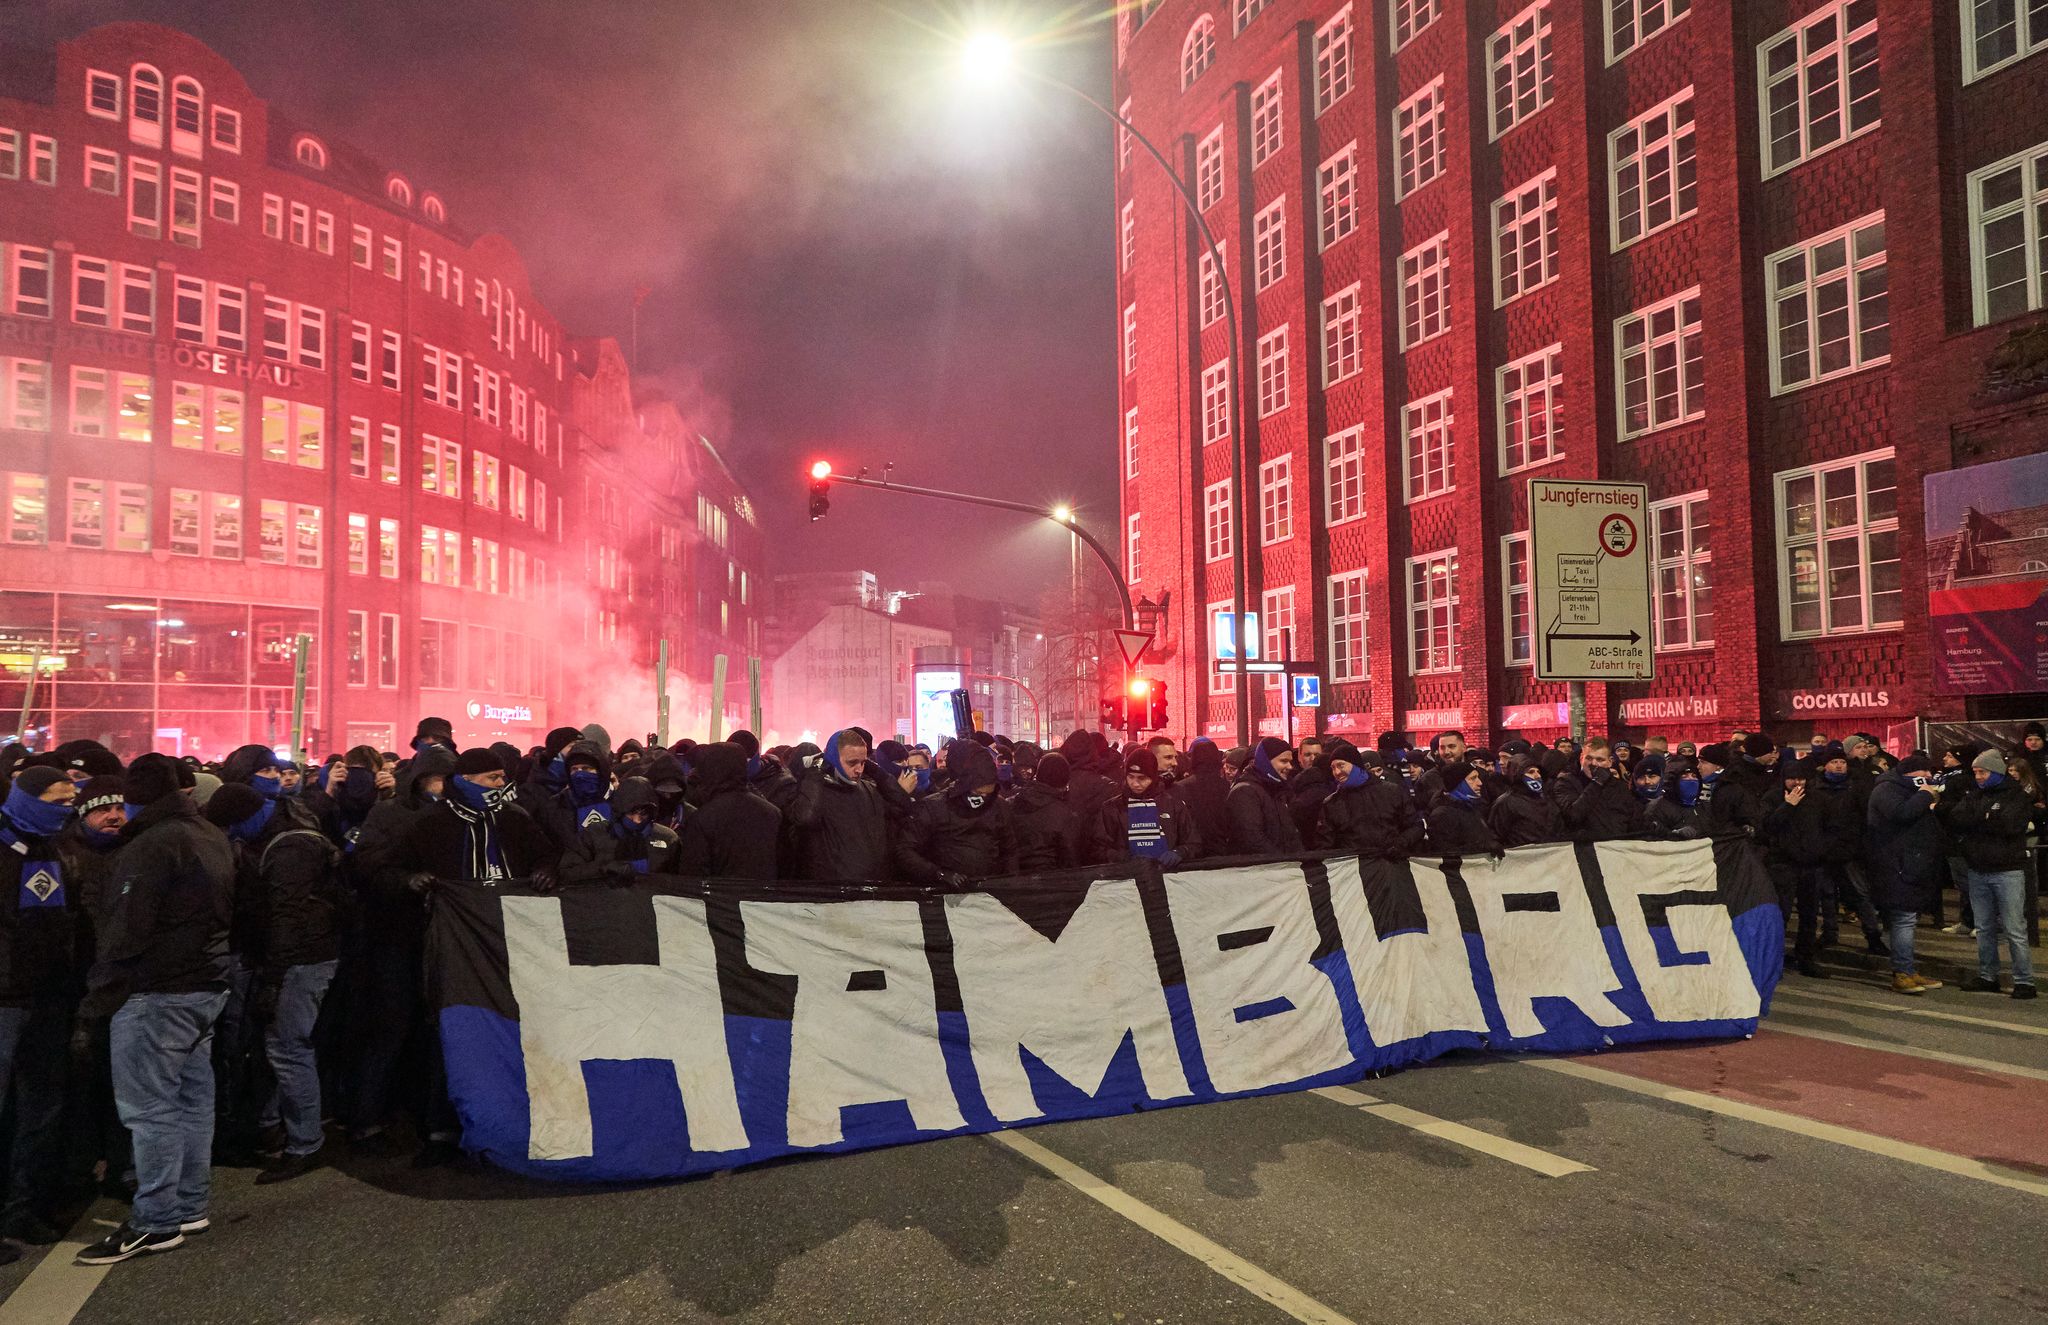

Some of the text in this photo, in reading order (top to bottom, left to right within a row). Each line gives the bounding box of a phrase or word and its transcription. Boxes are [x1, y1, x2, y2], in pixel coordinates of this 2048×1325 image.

[154, 343, 228, 375] BÖSE
[235, 358, 304, 390] HAUS
[1540, 486, 1639, 509] Jungfernstieg
[1560, 557, 1595, 566] Linienverkehr
[1575, 567, 1590, 575] Taxi
[1583, 576, 1595, 584] frei
[1561, 594, 1596, 603] Lieferverkehr
[1569, 604, 1590, 612] 21-11h
[1573, 613, 1586, 621] frei
[1588, 647, 1643, 657] ABC-Straße
[1946, 648, 1982, 656] Hamburg
[1590, 660, 1644, 670] Zufahrt frei
[1792, 691, 1889, 710] COCKTAILS
[1618, 701, 1685, 719] AMERICAN
[1409, 711, 1461, 726] HAPPY HOUR
[501, 836, 1762, 1160] HAMBURG
